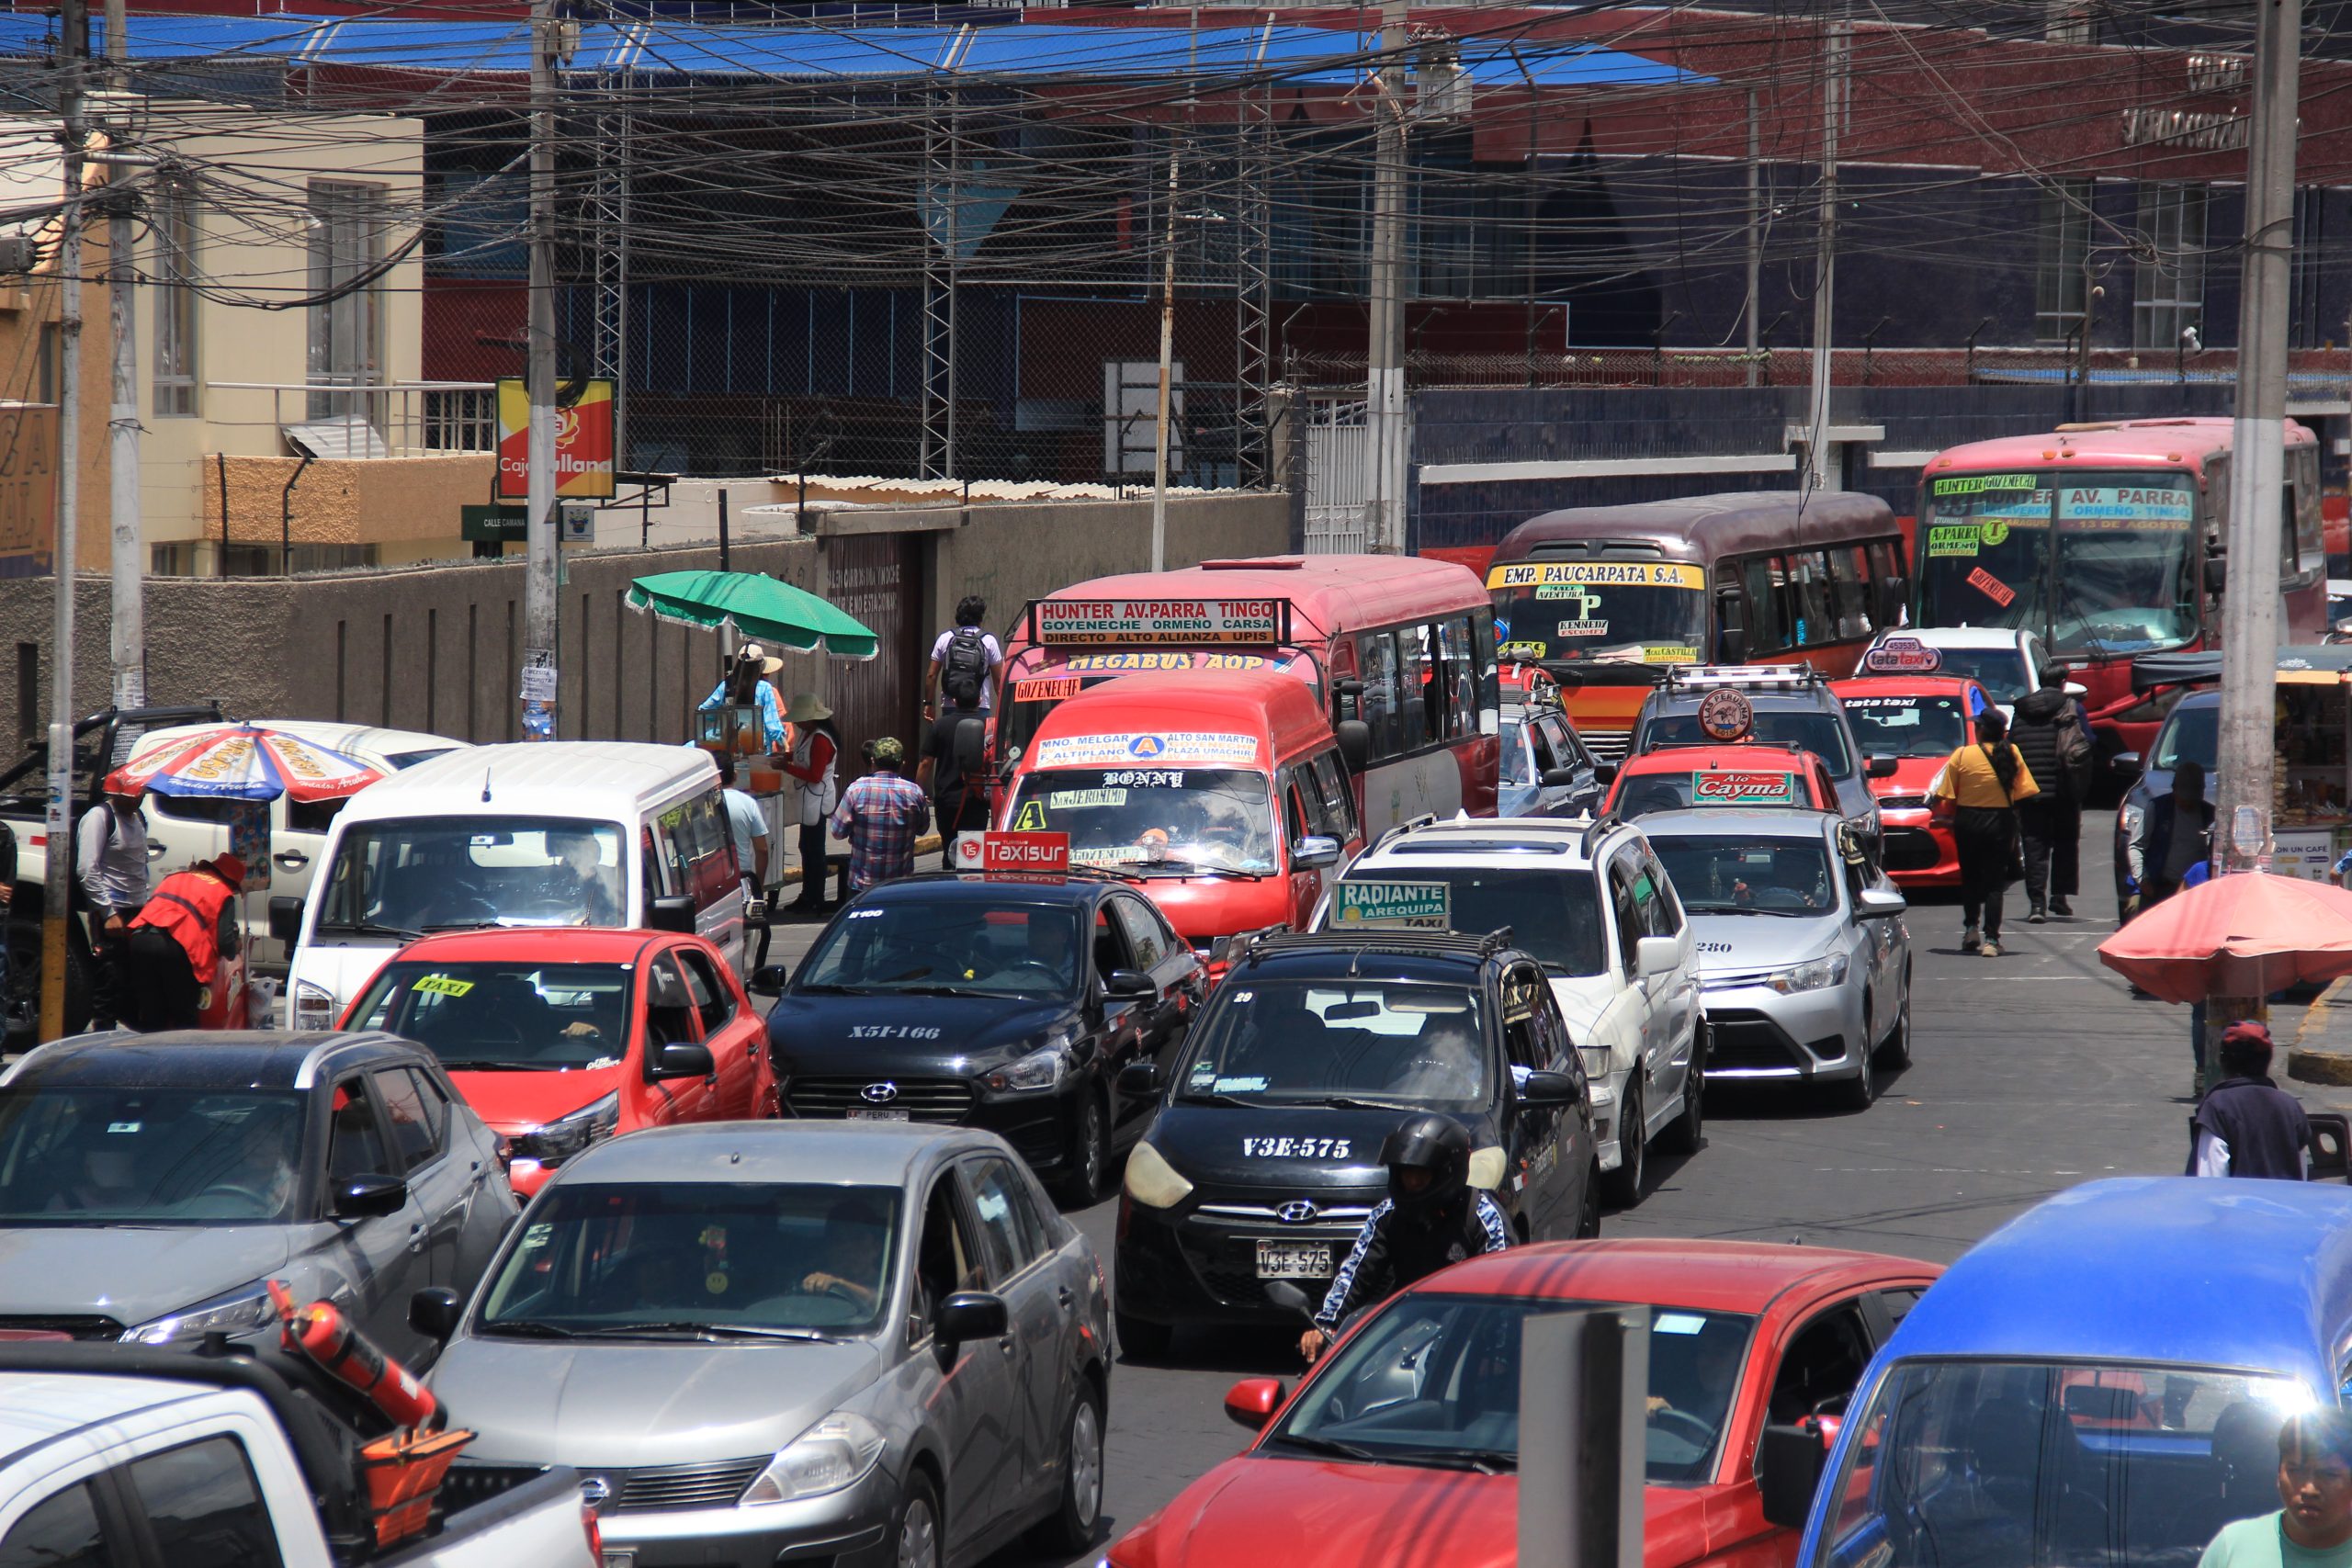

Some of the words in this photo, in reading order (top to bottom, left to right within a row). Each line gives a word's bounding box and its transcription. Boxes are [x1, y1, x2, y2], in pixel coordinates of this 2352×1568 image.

[1936, 479, 1984, 494] HUNTER
[1985, 475, 2035, 489] GOYENECHE
[2071, 489, 2102, 504] AV.
[2117, 489, 2189, 506] PARRA
[2074, 504, 2134, 516] ORMEÑO
[484, 518, 502, 527] CALLE
[2079, 520, 2097, 529] 13
[2101, 521, 2120, 529] DE
[2125, 521, 2190, 530] AGOSTO
[1943, 525, 1978, 540] PARRA
[1504, 567, 1537, 584] EMP.
[1544, 566, 1646, 582] PAUCARPATA
[1654, 566, 1684, 584] S.A.
[1537, 591, 1583, 599] AVENTURA
[1042, 603, 1114, 619] HUNTER
[1123, 602, 1206, 619] AV.PARRA
[1217, 601, 1274, 618] TINGO
[1579, 594, 1601, 620] P
[1041, 619, 1141, 631] GOYENECHE
[1152, 617, 1213, 630] ORMEÑO
[1222, 618, 1272, 629] CARSA
[1560, 620, 1608, 630] KENNEDY
[1045, 632, 1107, 643] DIRECTO
[1115, 631, 1154, 642] ALTO
[1158, 631, 1222, 642] ALIANZA
[1232, 631, 1268, 641] UPIS
[1661, 647, 1697, 657] CASTILLA
[1065, 652, 1194, 671] MEGABUS
[1205, 652, 1265, 671] AOP
[1845, 698, 1882, 708] tata
[1883, 697, 1917, 707] taxi
[1041, 739, 1072, 750] MNO.
[1077, 734, 1130, 746] MELGAR
[1134, 737, 1159, 754] A
[1168, 733, 1193, 742] ALTO
[1195, 733, 1218, 743] SAN
[1218, 734, 1257, 745] MARTIN
[1170, 741, 1255, 750] GOYENECHE
[1054, 748, 1126, 759] ALTIPLANO
[1078, 753, 1121, 763] LIMA
[1168, 747, 1200, 756] PLAZA
[1102, 771, 1184, 788] BONNY
[1700, 781, 1786, 799] Cayma
[987, 840, 1065, 862] Taxisur
[1344, 885, 1442, 906] RADIANTE
[1365, 903, 1443, 918] AREQUIPA
[1404, 919, 1443, 928] TAXI
[421, 980, 466, 994] TAXI
[1233, 992, 1253, 1002] 29
[866, 1111, 889, 1119] PERU
[1243, 1137, 1351, 1159] V3E-575
[1261, 1250, 1329, 1274] V3E-575
